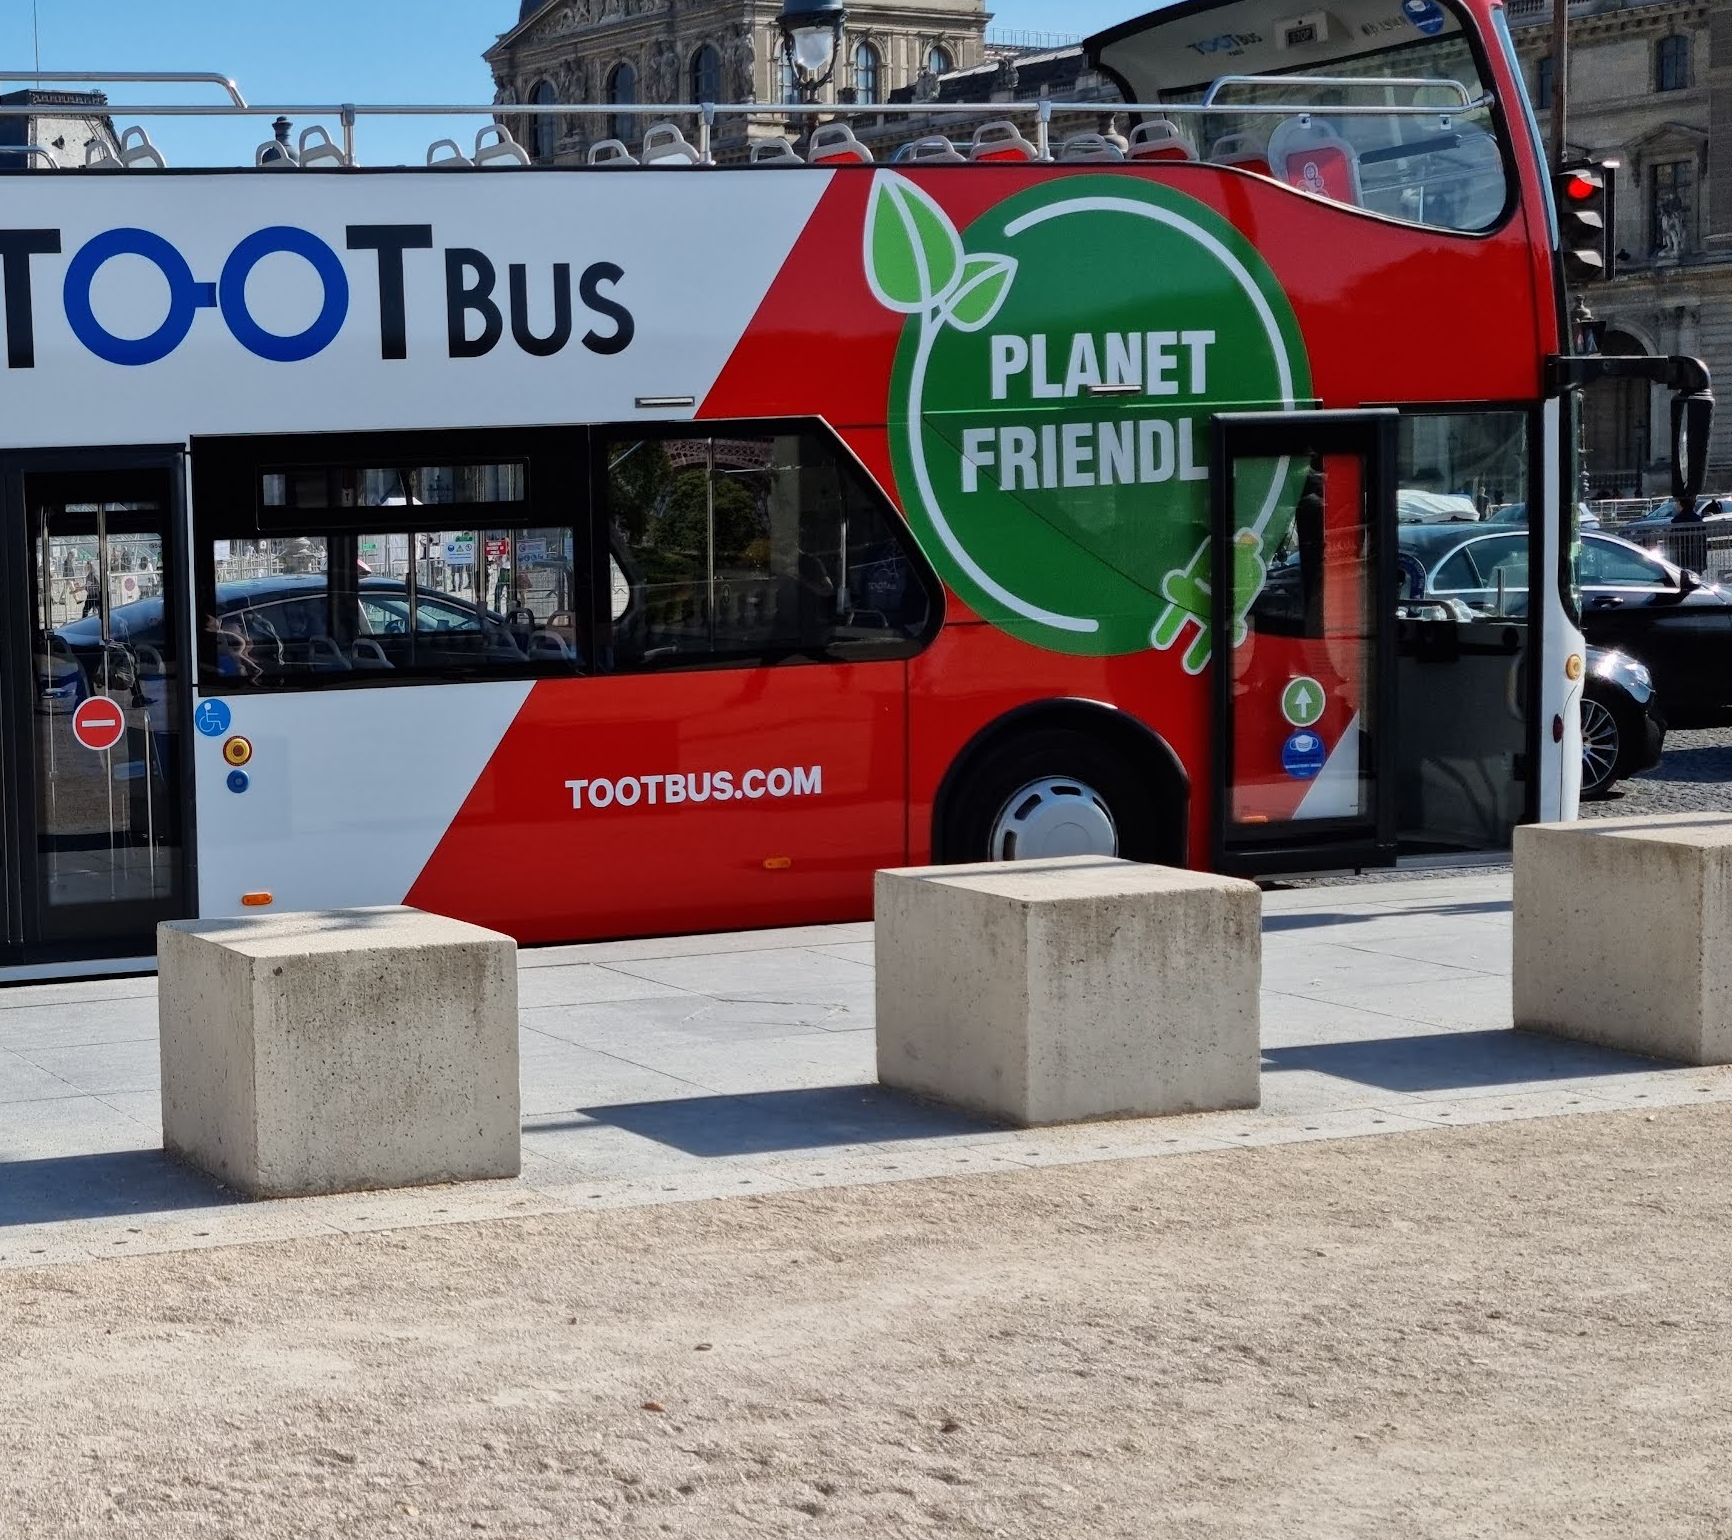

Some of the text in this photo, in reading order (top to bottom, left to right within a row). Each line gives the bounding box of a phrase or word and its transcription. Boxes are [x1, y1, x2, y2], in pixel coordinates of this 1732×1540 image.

[989, 330, 1216, 400] PLANET
[960, 417, 1210, 493] FRIENDL
[565, 765, 823, 809] TOOTBUS.COM
